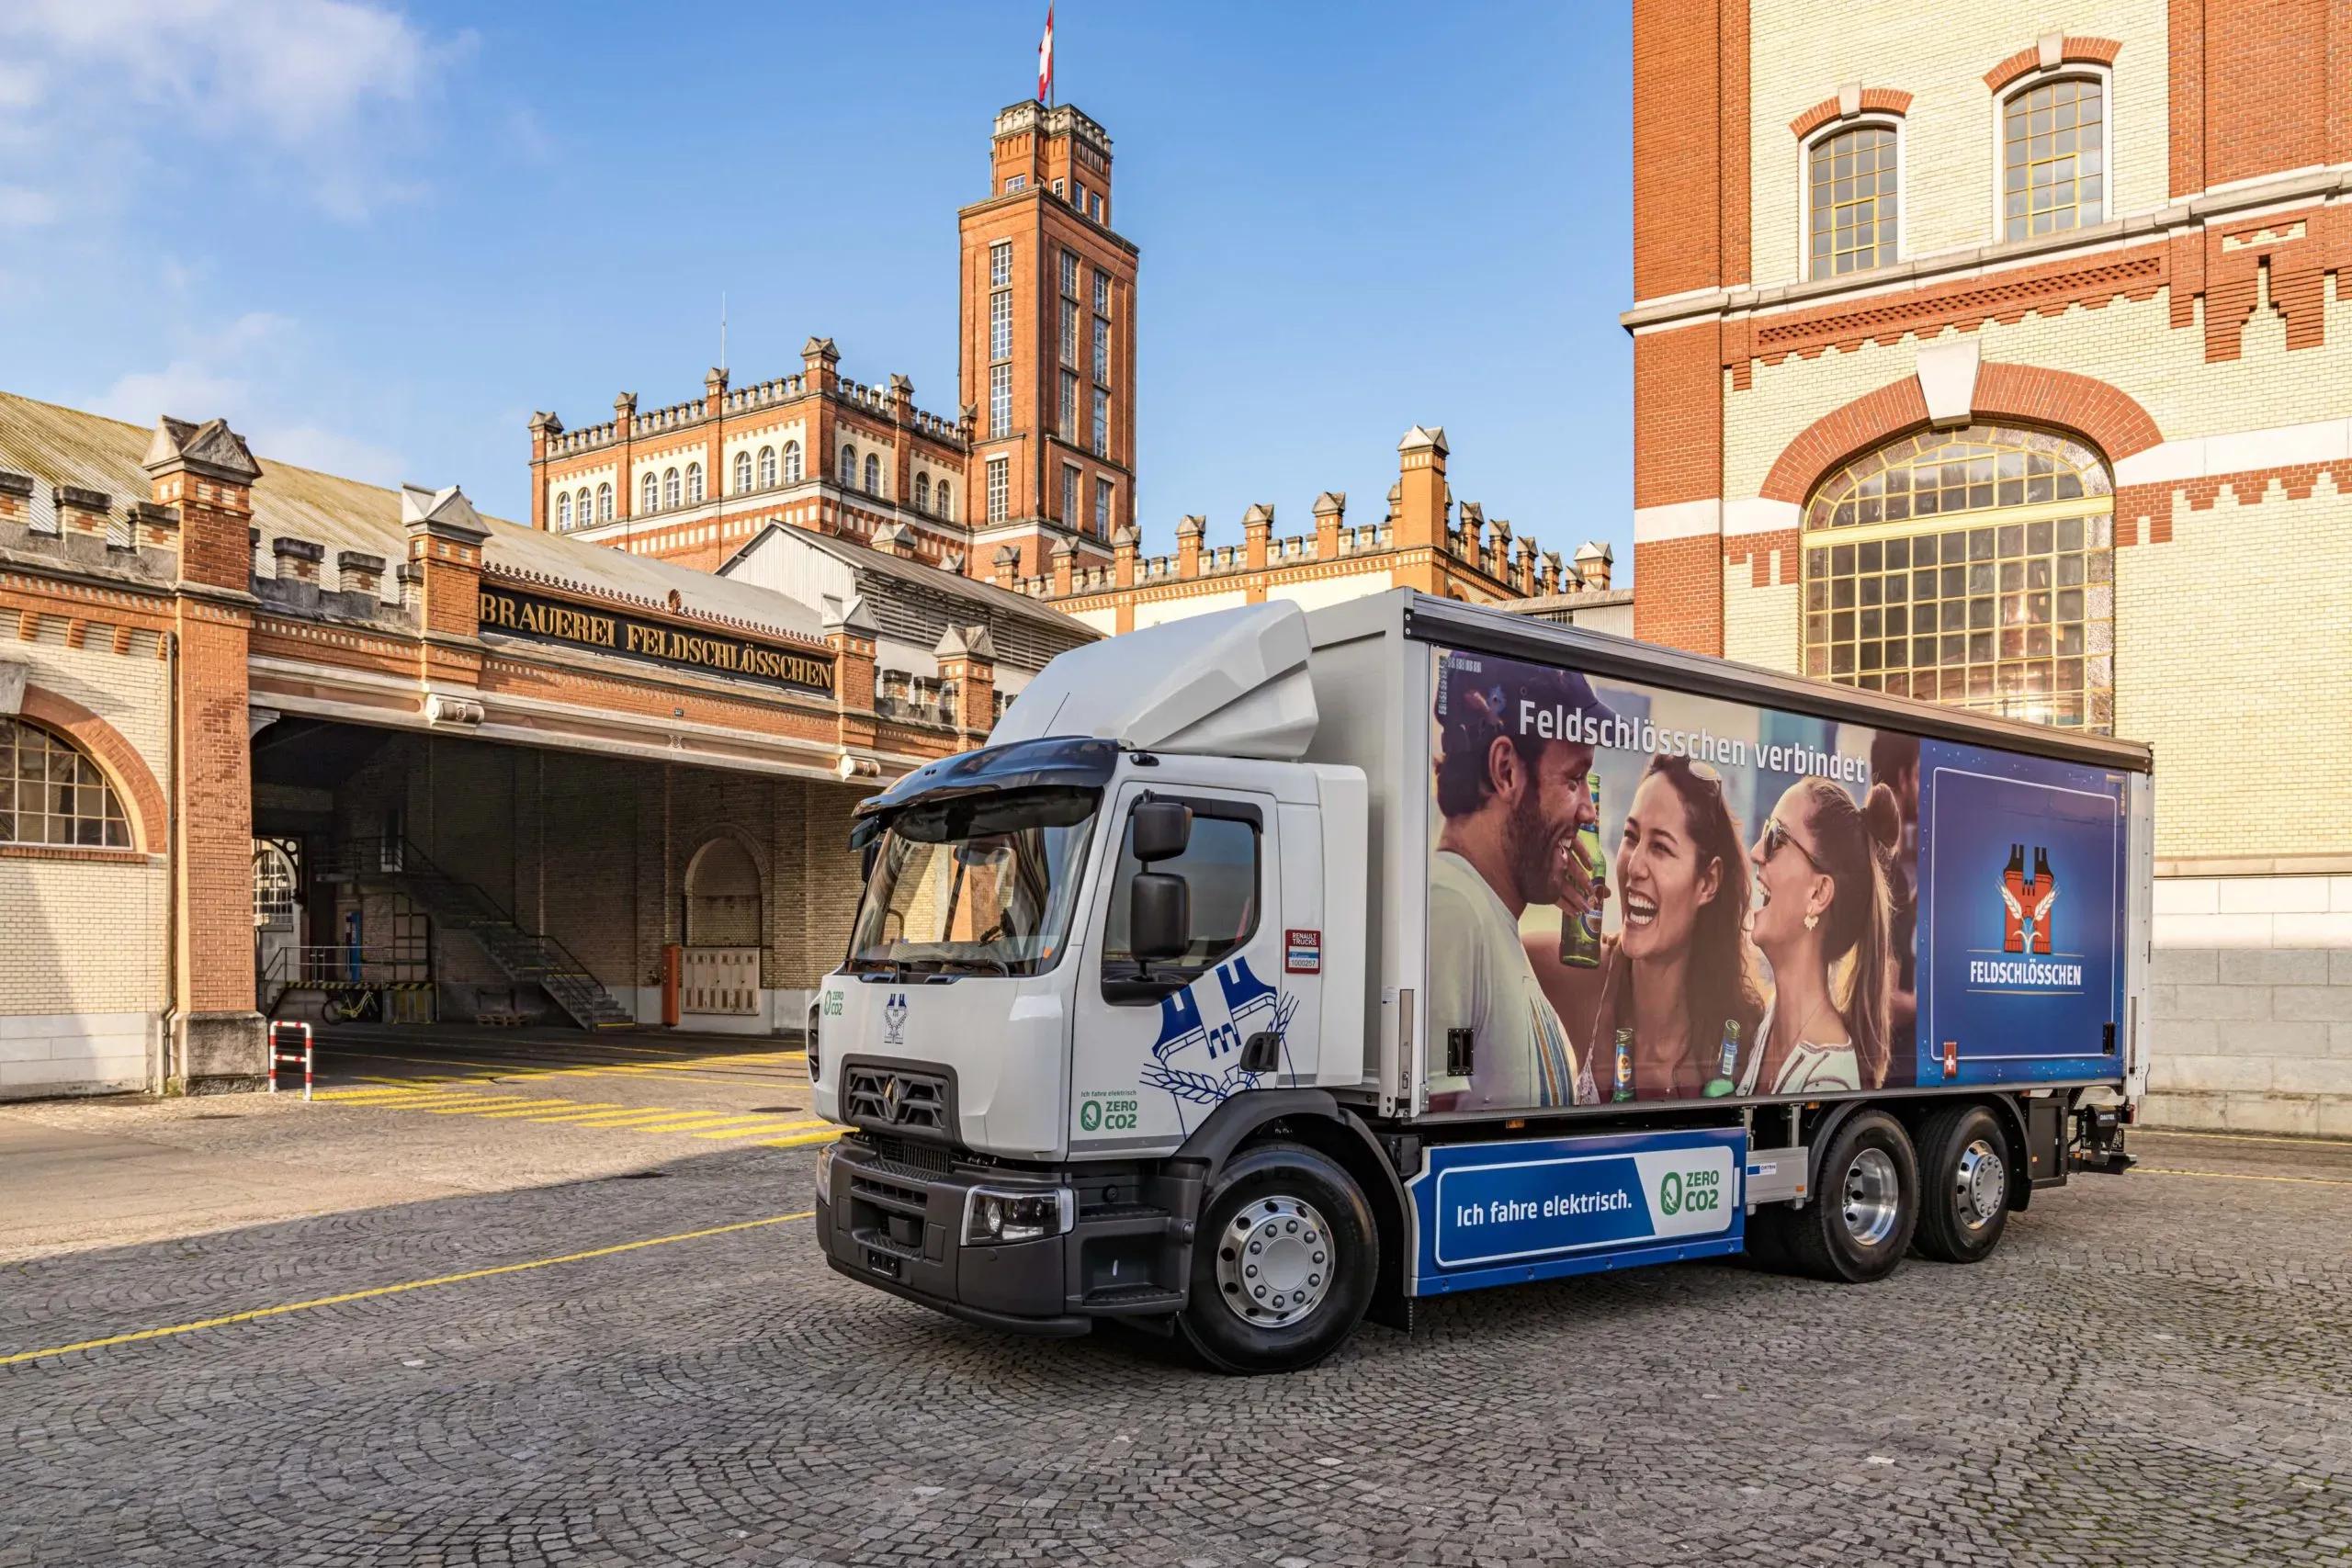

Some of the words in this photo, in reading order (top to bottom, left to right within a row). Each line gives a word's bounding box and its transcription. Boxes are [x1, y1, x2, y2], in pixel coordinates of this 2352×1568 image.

[480, 592, 616, 647] BRAUEREI
[627, 624, 832, 688] FELDSCHLÖSSCHEN
[1519, 699, 1746, 766] Feldschlösschen
[1754, 742, 1865, 784] verbindet
[1292, 938, 1317, 946] TRUCKS
[1970, 958, 2082, 987] FELDSCHLÖSSCHEN
[832, 991, 843, 999] ZERO
[831, 1002, 842, 1015] CO2
[1105, 1100, 1138, 1112] ZERO
[1104, 1113, 1137, 1130] CO2
[1686, 1169, 1720, 1188] ZERO
[1457, 1203, 1484, 1227] Ich
[1490, 1199, 1538, 1224] fahre
[1543, 1189, 1633, 1218] elektrisch.
[1685, 1189, 1719, 1213] CO2
